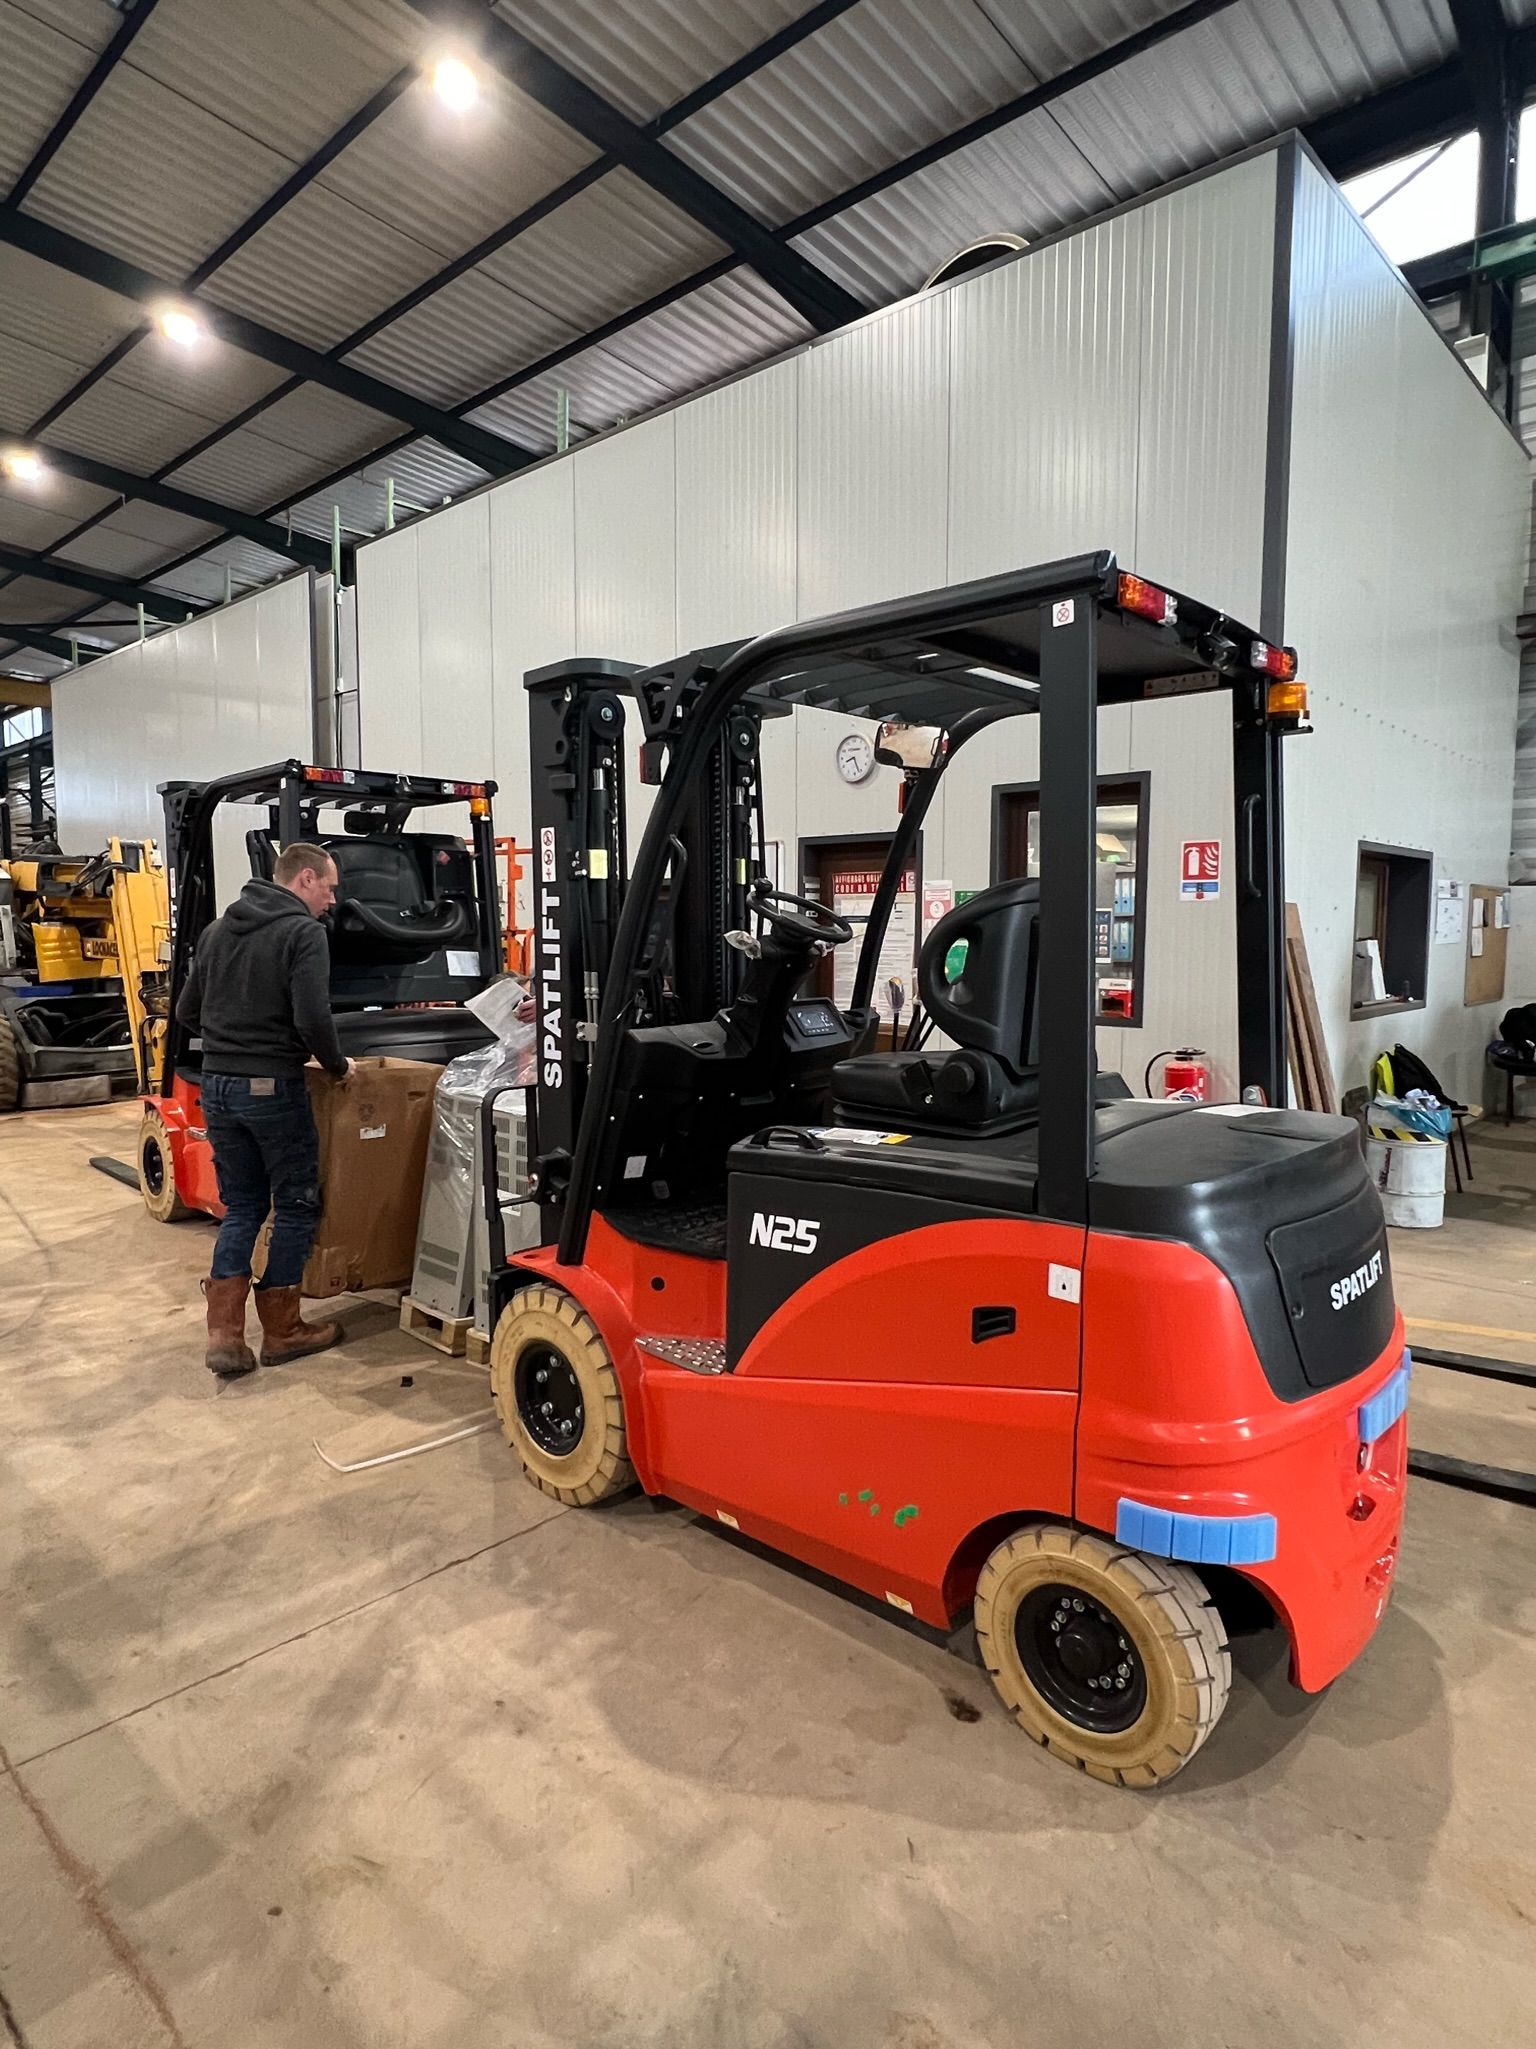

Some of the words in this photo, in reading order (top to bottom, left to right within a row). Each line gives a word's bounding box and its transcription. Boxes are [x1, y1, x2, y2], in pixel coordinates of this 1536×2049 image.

[835, 884, 854, 893] CODE
[541, 887, 563, 1089] SPATLIFT
[749, 1212, 821, 1255] N25
[1330, 1249, 1383, 1310] SPATLIFT
